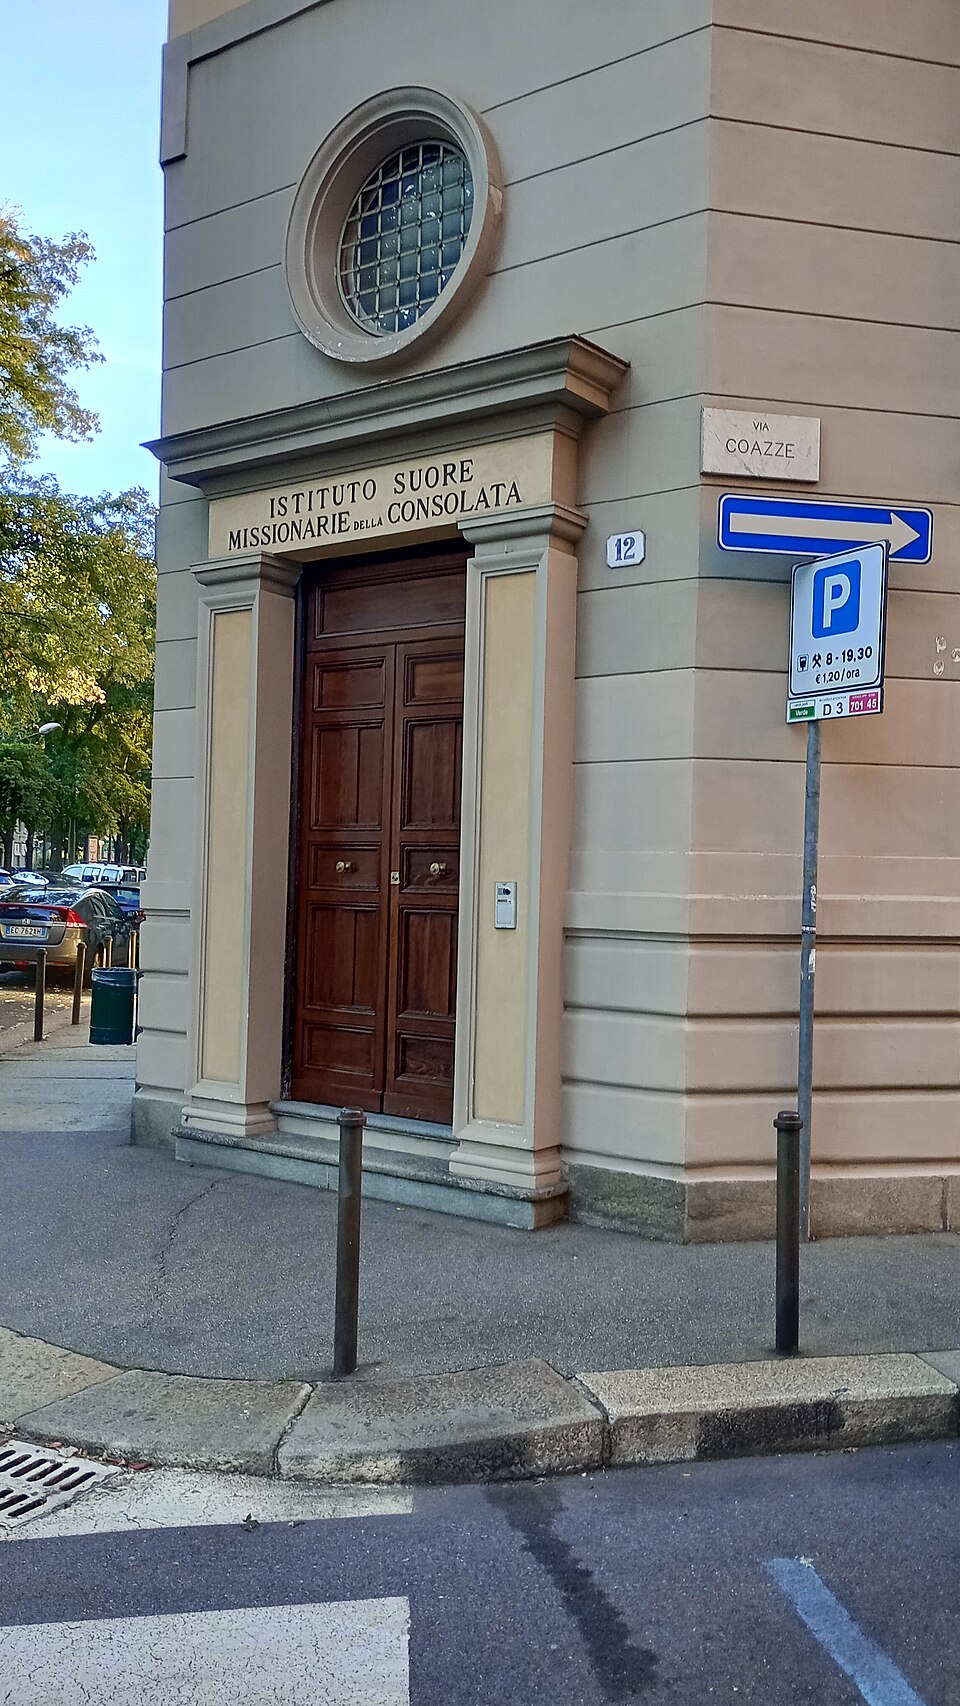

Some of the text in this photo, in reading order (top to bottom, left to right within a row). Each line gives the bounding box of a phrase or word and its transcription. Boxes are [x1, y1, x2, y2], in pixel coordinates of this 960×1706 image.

[752, 421, 770, 431] VIA
[725, 438, 795, 459] COAZZE
[269, 459, 474, 519] ISTITUTO SUORE
[228, 481, 523, 551] MISSIONARIE DELLA CONSOLATA
[615, 536, 636, 561] 12
[822, 573, 851, 629] P
[826, 652, 833, 666] 8
[822, 703, 832, 716] D
[836, 701, 844, 715] 3
[850, 697, 877, 712] 701 45
